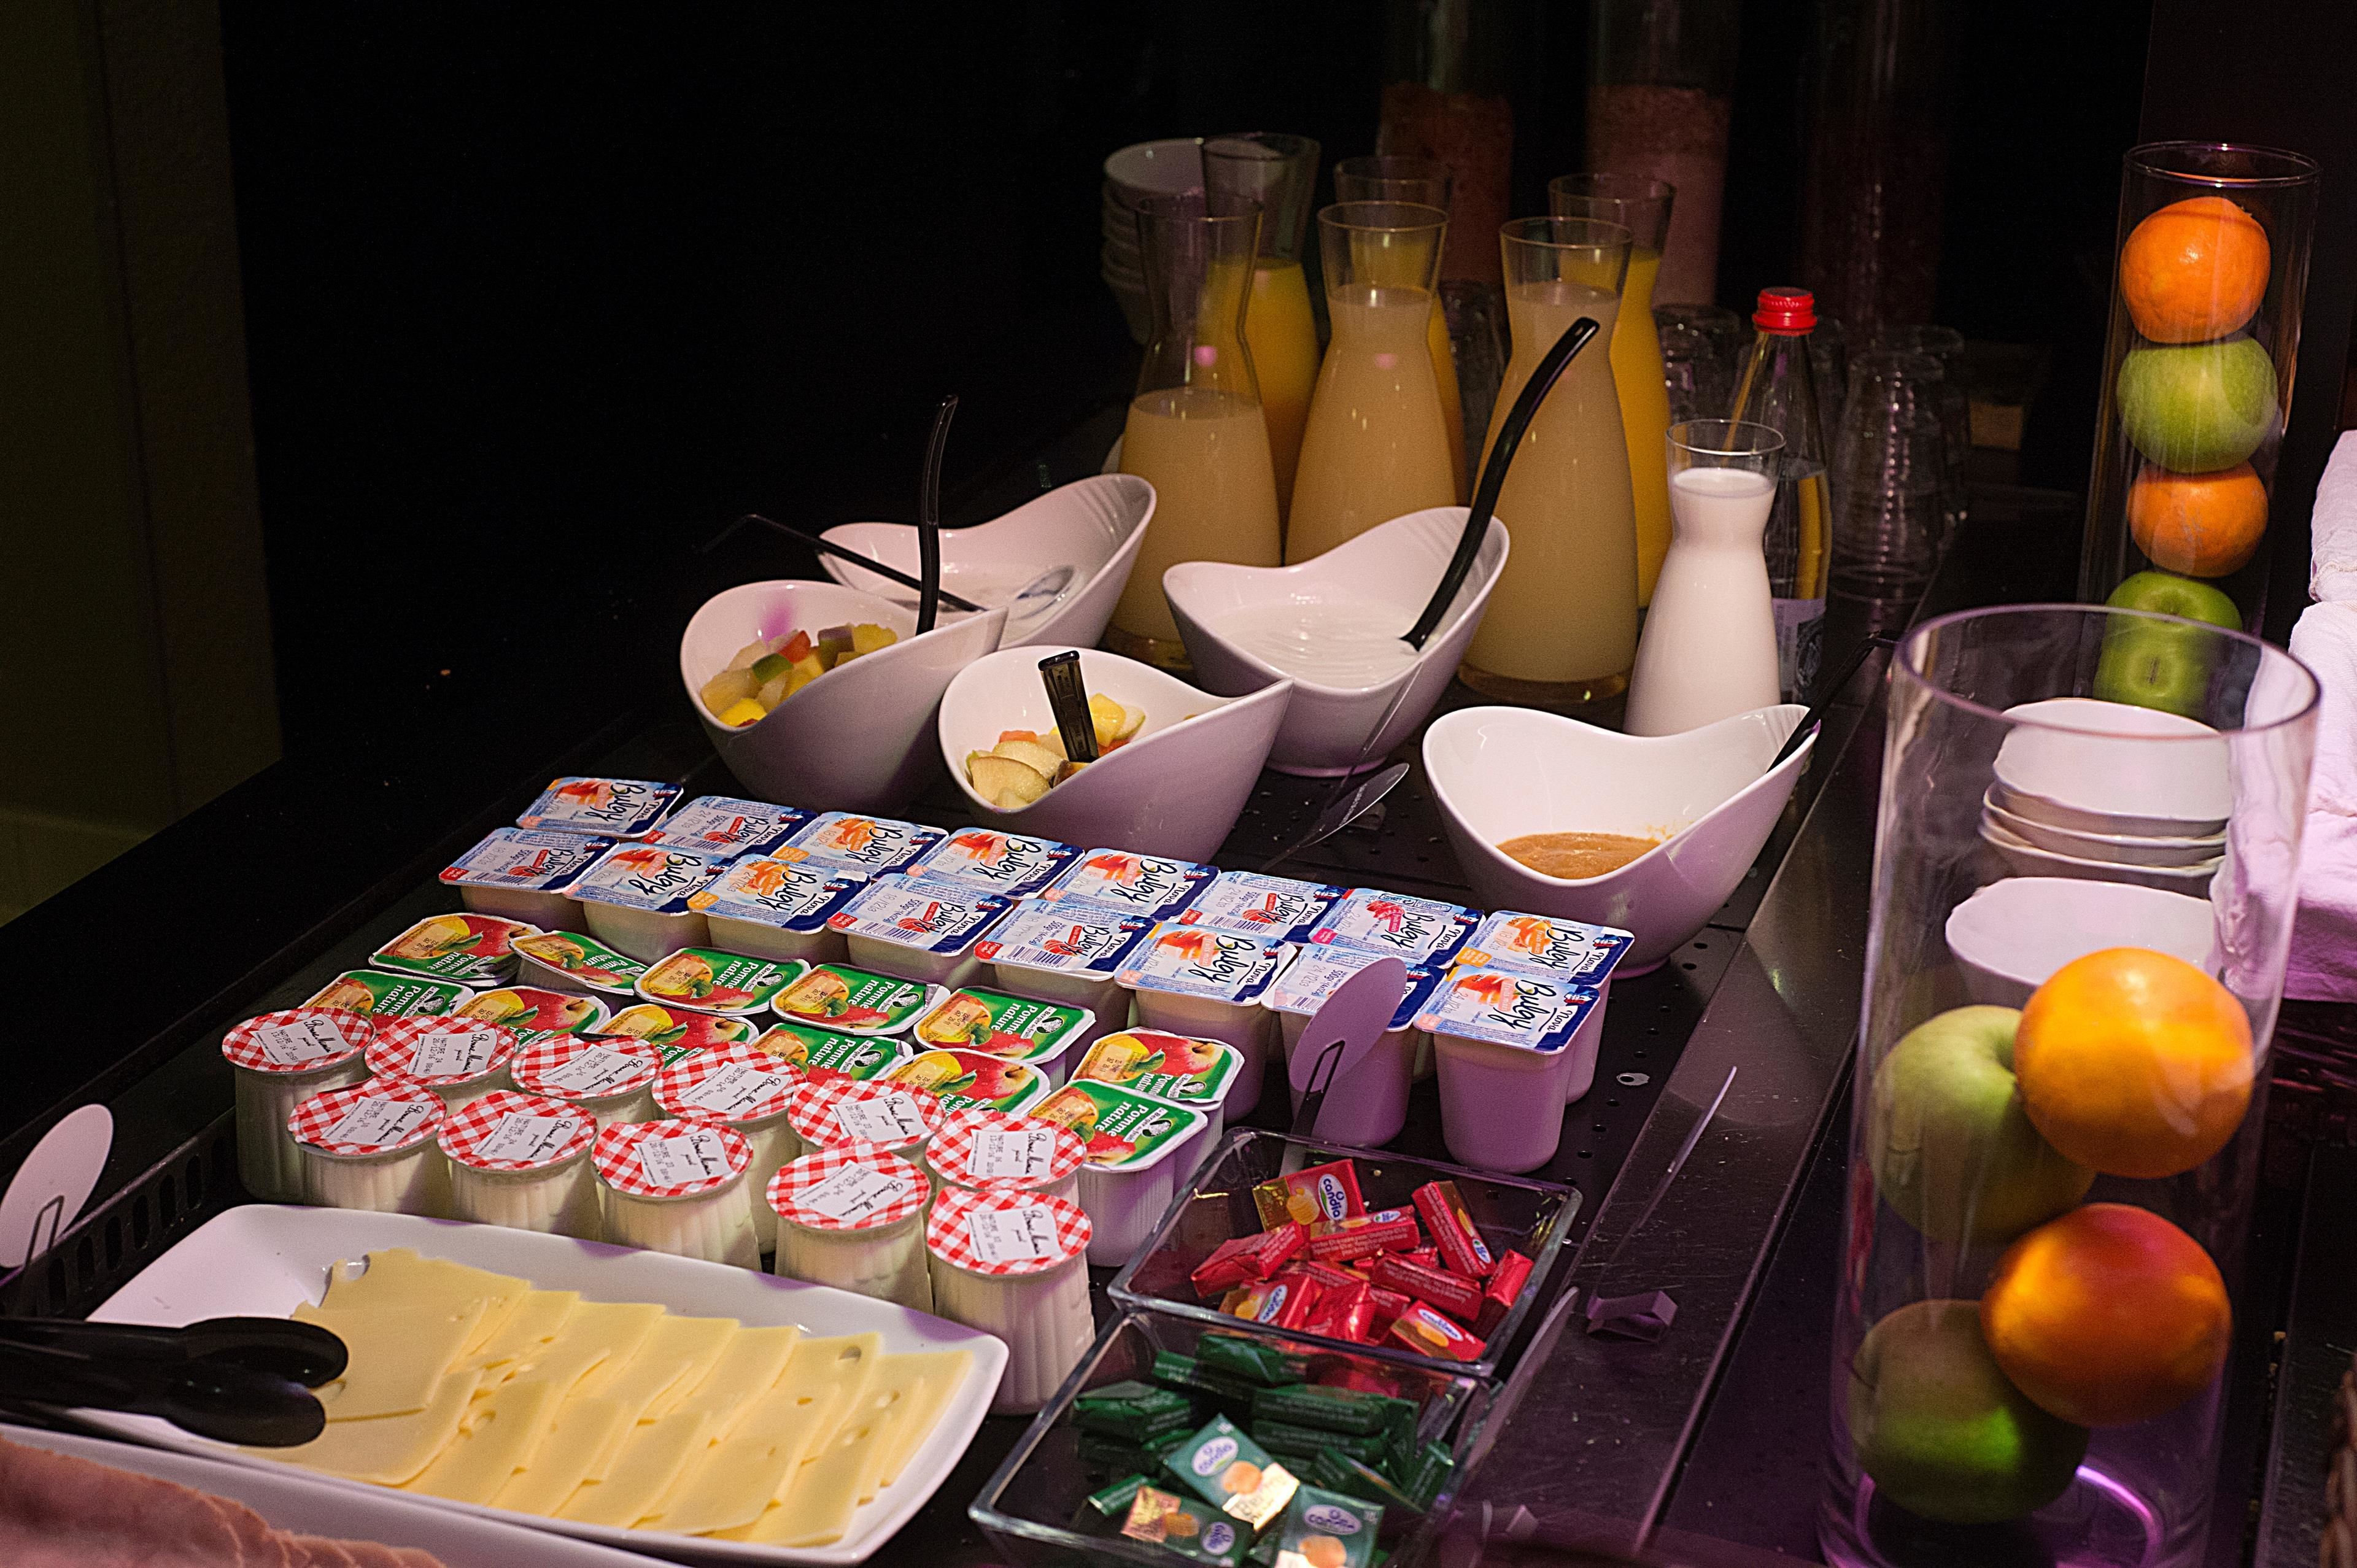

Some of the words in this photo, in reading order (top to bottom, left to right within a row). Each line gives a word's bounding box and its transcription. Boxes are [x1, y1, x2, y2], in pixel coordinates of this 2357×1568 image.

[586, 783, 646, 821] Bulgy
[721, 816, 768, 843] Bulgy
[846, 827, 902, 863] Bulgy
[973, 838, 1041, 879] Bulgy
[525, 849, 574, 876] Bulgy
[629, 853, 701, 896] Bulgy
[756, 870, 816, 913] Bulgy
[1111, 859, 1177, 902] Bulgy
[915, 902, 965, 934] Bulgy
[1259, 894, 1304, 924] Bulgy
[1061, 925, 1109, 957] Bulgy
[1381, 913, 1434, 948] Bulgy
[1189, 935, 1255, 982] Bulgy
[1529, 928, 1584, 968] Bulgy
[713, 961, 741, 984] nature
[725, 962, 759, 988] Pomme
[751, 967, 772, 979] Berger
[373, 986, 404, 1013] nature
[385, 986, 420, 1016] Pomme
[413, 991, 435, 1005] Berger
[848, 980, 878, 1004] nature
[861, 982, 895, 1008] Pomme
[888, 987, 910, 999] Berger
[1488, 981, 1555, 1029] Bulgy
[991, 1003, 1021, 1030] nature
[1004, 1005, 1037, 1034] Pomme
[1032, 1010, 1051, 1024] Berger
[469, 1034, 489, 1052] Bonne
[808, 1038, 838, 1064] nature
[821, 1039, 856, 1068] Pomme
[848, 1044, 870, 1059] Berger
[463, 1052, 482, 1072] Maman
[613, 1059, 643, 1074] Bonne
[582, 1075, 613, 1090] Maman
[751, 1076, 781, 1092] Bonne
[1171, 1076, 1189, 1089] Berger
[397, 1105, 424, 1122] Bonne
[726, 1093, 756, 1110] Maman
[546, 1120, 571, 1138] Bonne
[1096, 1102, 1131, 1130] nature
[1107, 1105, 1148, 1137] Pomme
[1138, 1111, 1161, 1127] Berger
[375, 1122, 404, 1143] Maman
[528, 1139, 554, 1158] Maman
[1323, 1176, 1341, 1219] candia
